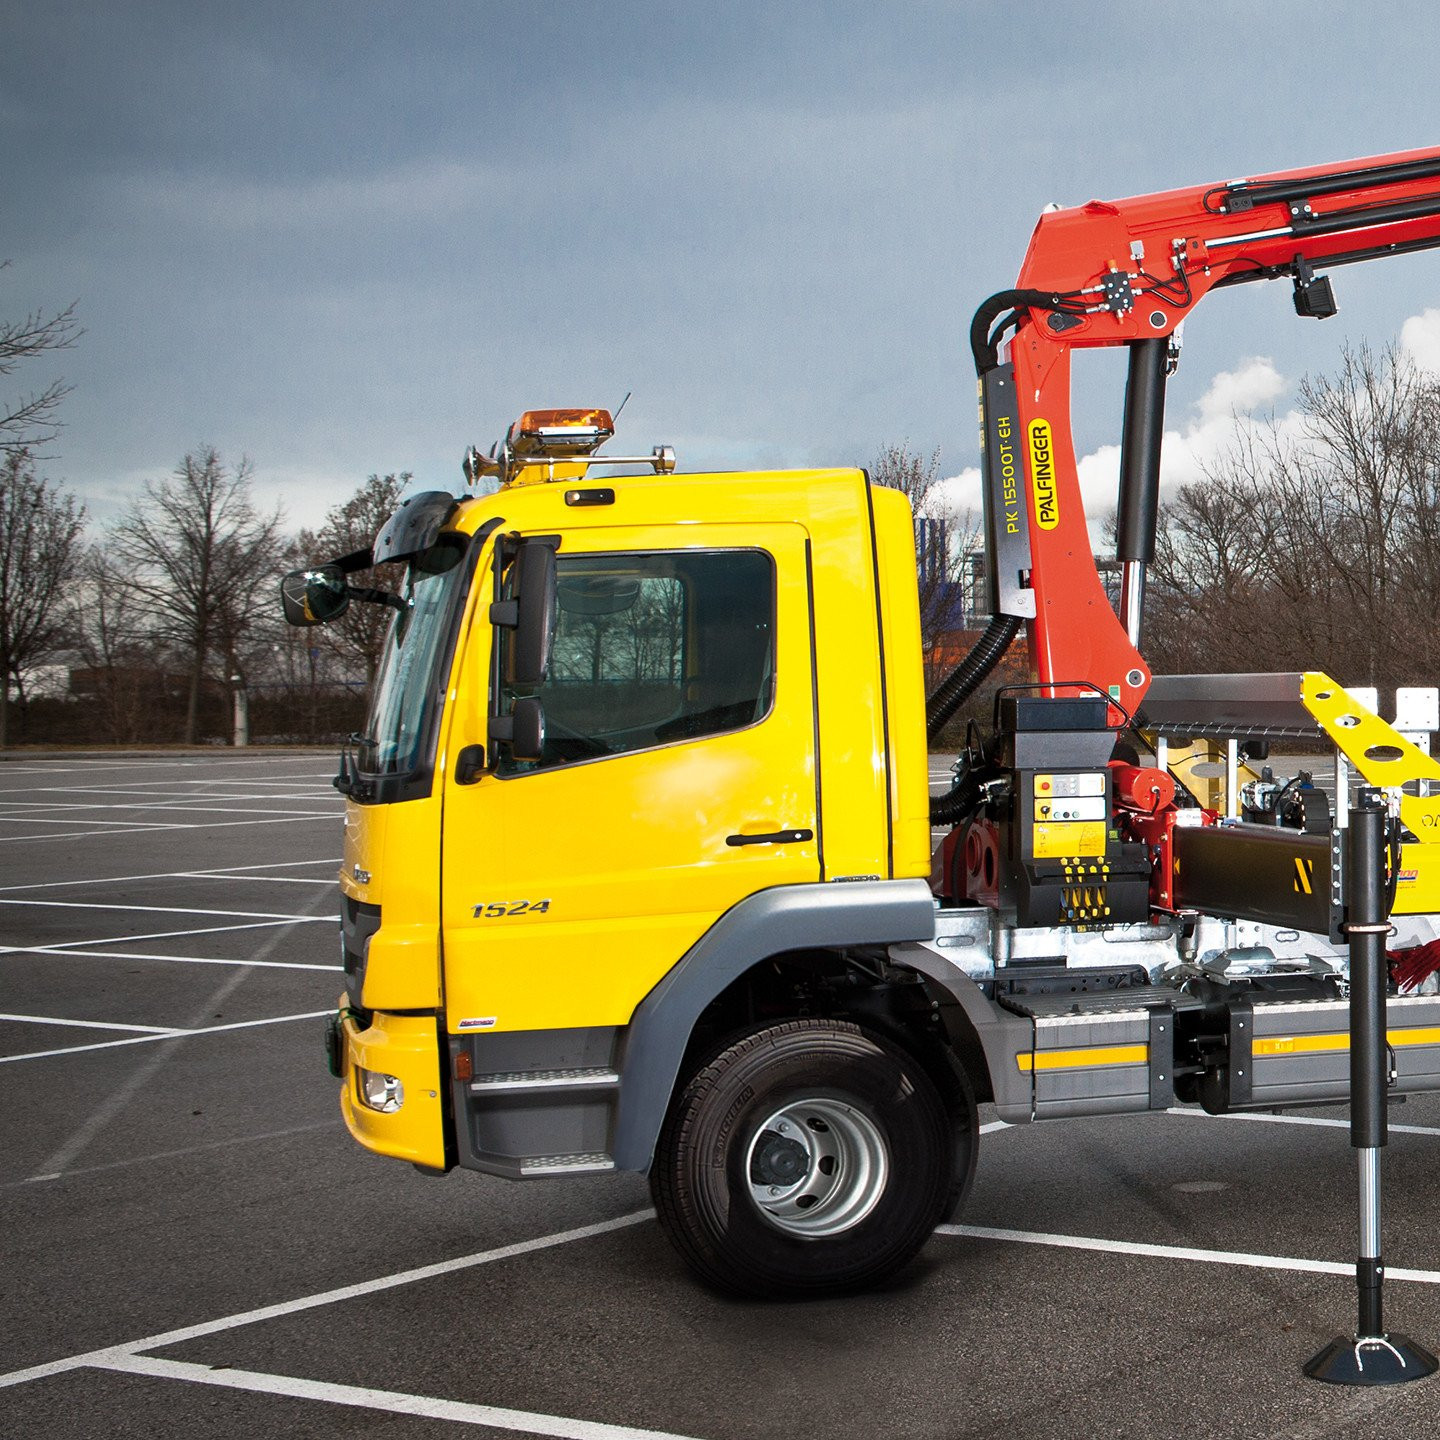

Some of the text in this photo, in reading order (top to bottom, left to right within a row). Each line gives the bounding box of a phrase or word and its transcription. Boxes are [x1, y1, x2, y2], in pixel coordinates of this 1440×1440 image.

[1032, 425, 1055, 523] PALFINGER
[1006, 510, 1019, 534] PK
[470, 898, 552, 919] 1524
[716, 1086, 755, 1151] MICHELIN
